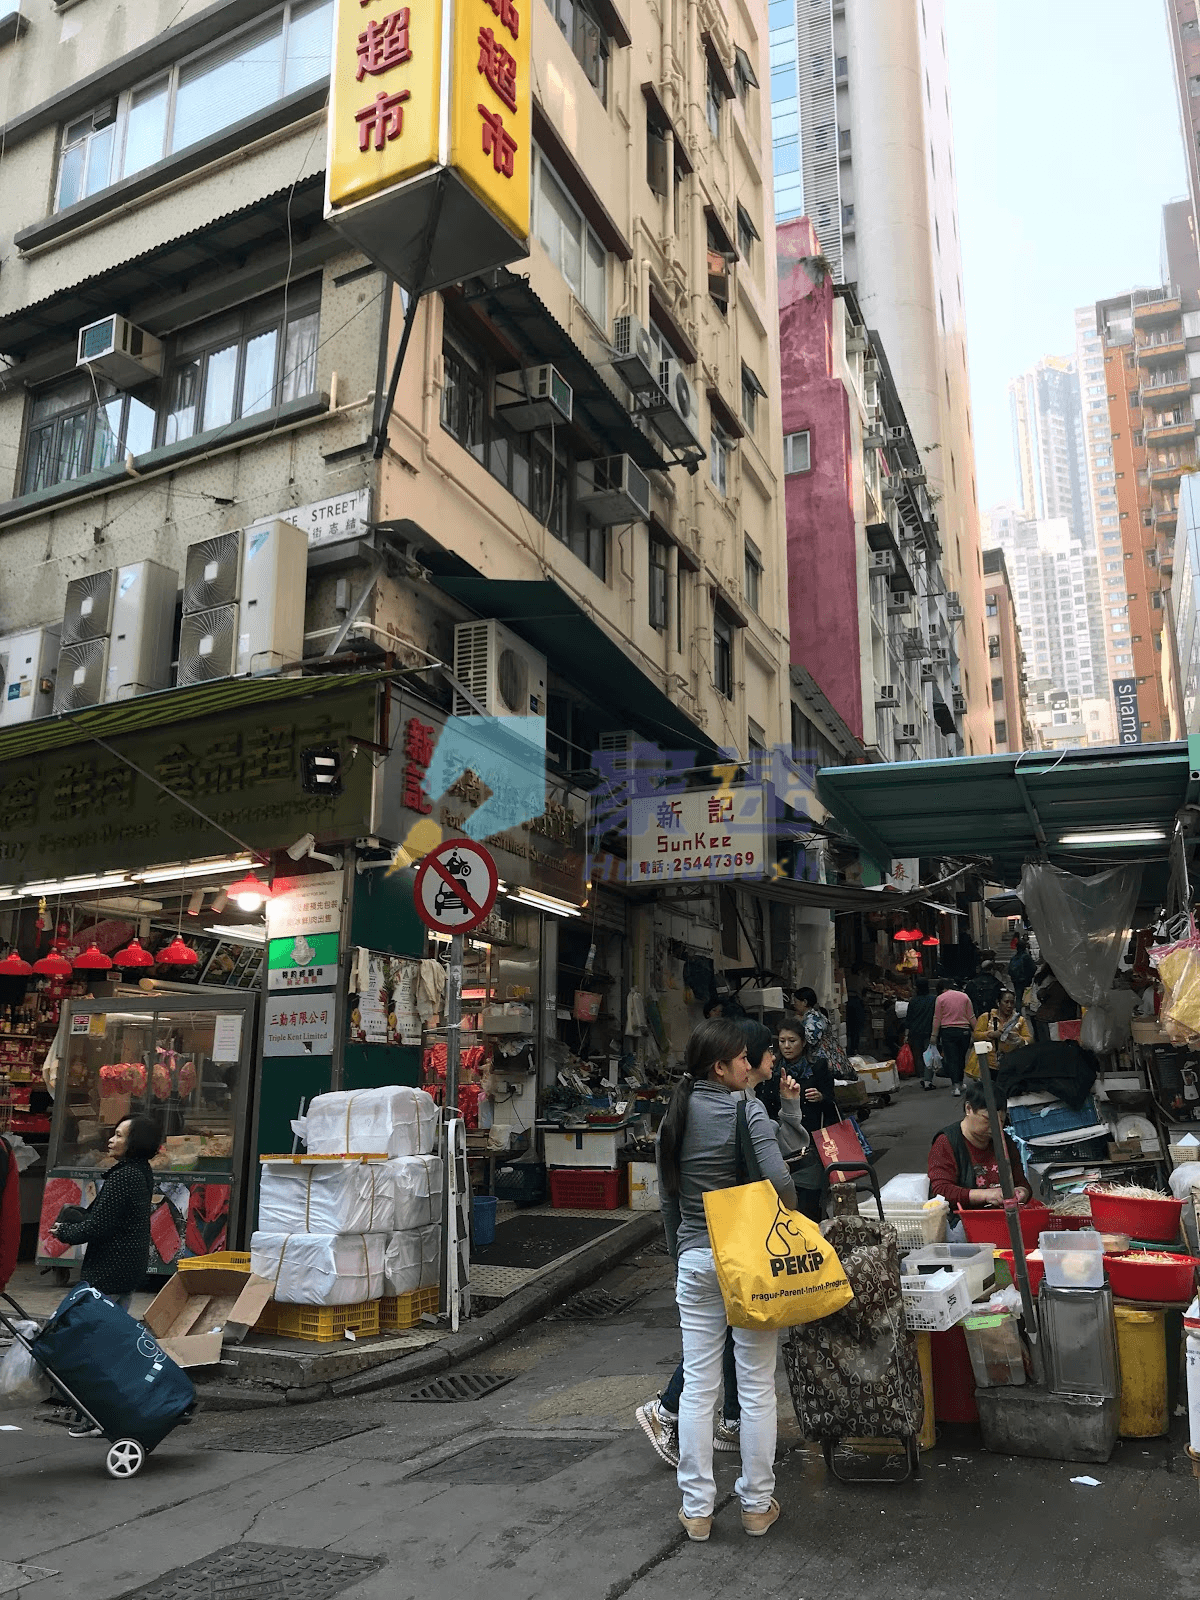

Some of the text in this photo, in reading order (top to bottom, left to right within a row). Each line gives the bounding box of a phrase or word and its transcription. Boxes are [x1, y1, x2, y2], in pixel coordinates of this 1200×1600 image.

[354, 0, 412, 153] 超市
[311, 498, 358, 523] STREET
[1118, 684, 1138, 744] shama
[268, 1032, 328, 1043] Triple Kent Limited
